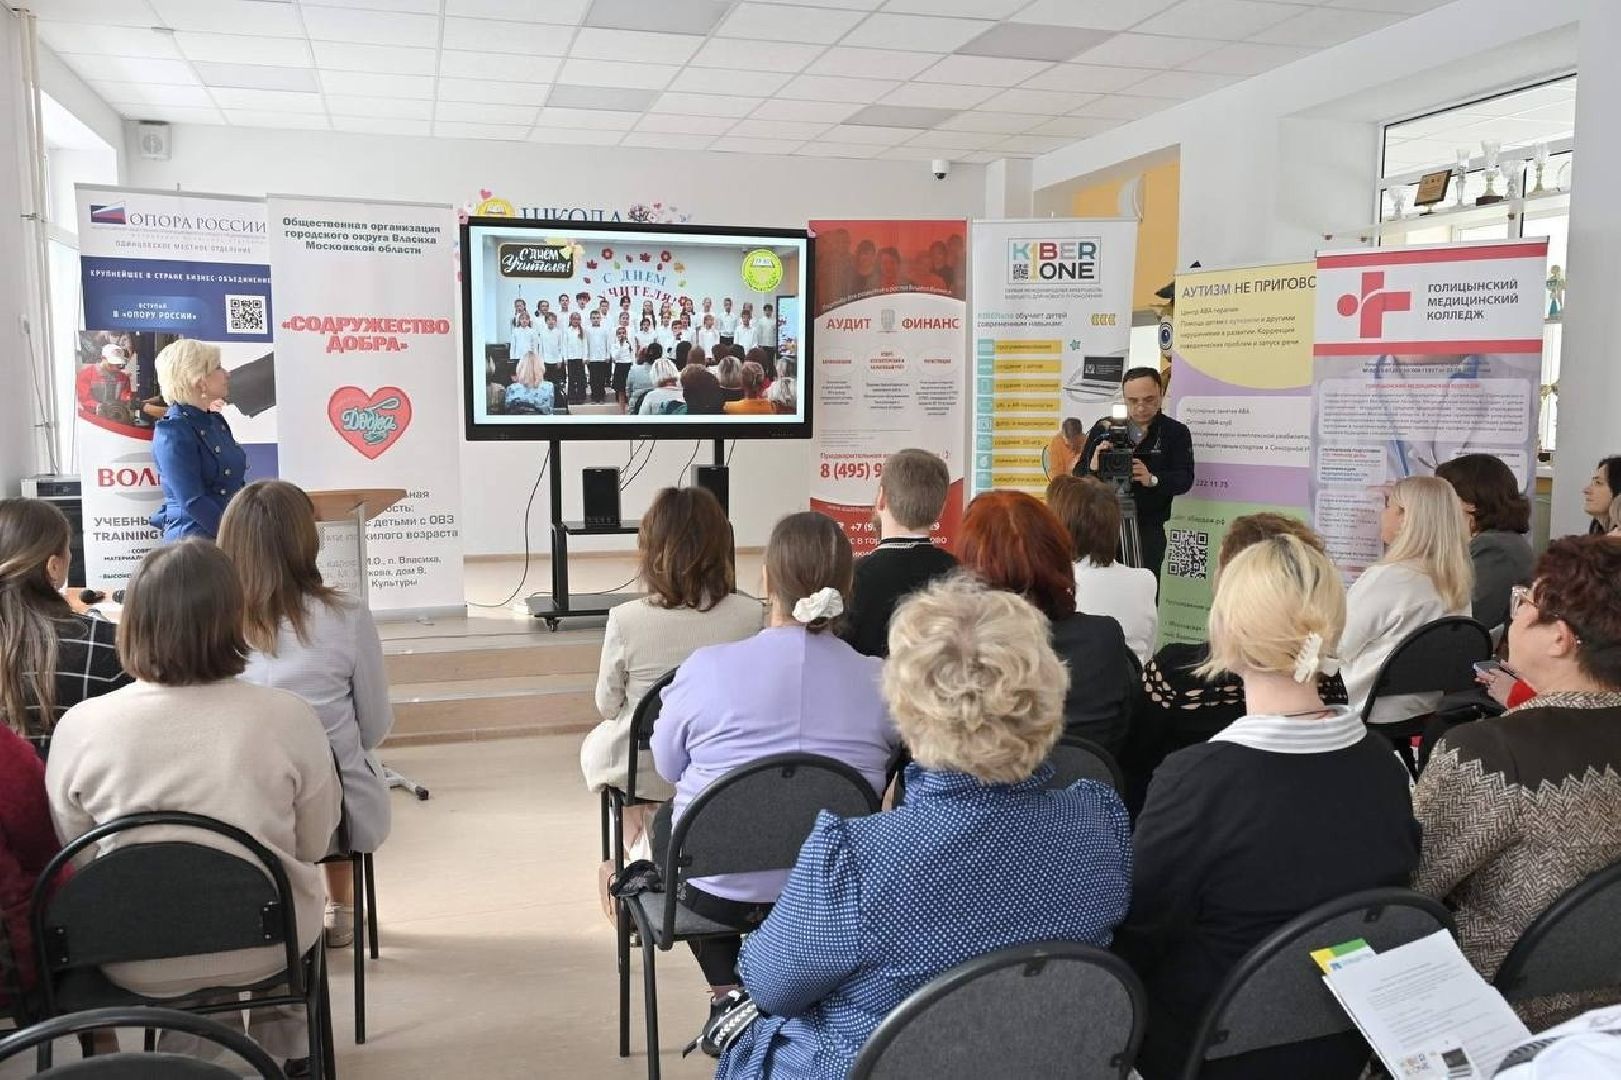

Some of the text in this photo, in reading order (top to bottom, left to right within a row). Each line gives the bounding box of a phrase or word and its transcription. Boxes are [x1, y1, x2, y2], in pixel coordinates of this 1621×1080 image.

[130, 213, 267, 233] ОПОРА РОССИИ
[282, 217, 440, 235] Общественная организация
[285, 230, 437, 244] городского округа Власиха
[305, 240, 422, 255] Московской области
[603, 269, 666, 286] С ДНЕМ
[1039, 262, 1095, 280] ONE
[1182, 283, 1231, 298] АУТИЗМ
[1234, 281, 1251, 294] НЕ
[1428, 278, 1518, 293] ГОЛИЦЫНСКИЙ
[1427, 294, 1519, 307] МЕДИЦИНСКИЙ
[159, 312, 197, 321] РОССИИ»
[1427, 310, 1484, 320] КОЛЛЕДЖ
[282, 315, 450, 335] «СОДРУЖЕСТВО
[825, 317, 960, 331] АУДИТ ФИНАНС
[326, 334, 408, 353] ДОБРА»
[98, 467, 160, 487] ВОЛ
[820, 463, 830, 478] 8
[833, 462, 871, 479] (495)
[374, 518, 417, 527] детьми
[429, 515, 455, 525] ОВЗ
[93, 530, 158, 541] TRAINING
[406, 530, 459, 540] возраста
[371, 579, 418, 589] Культуры
